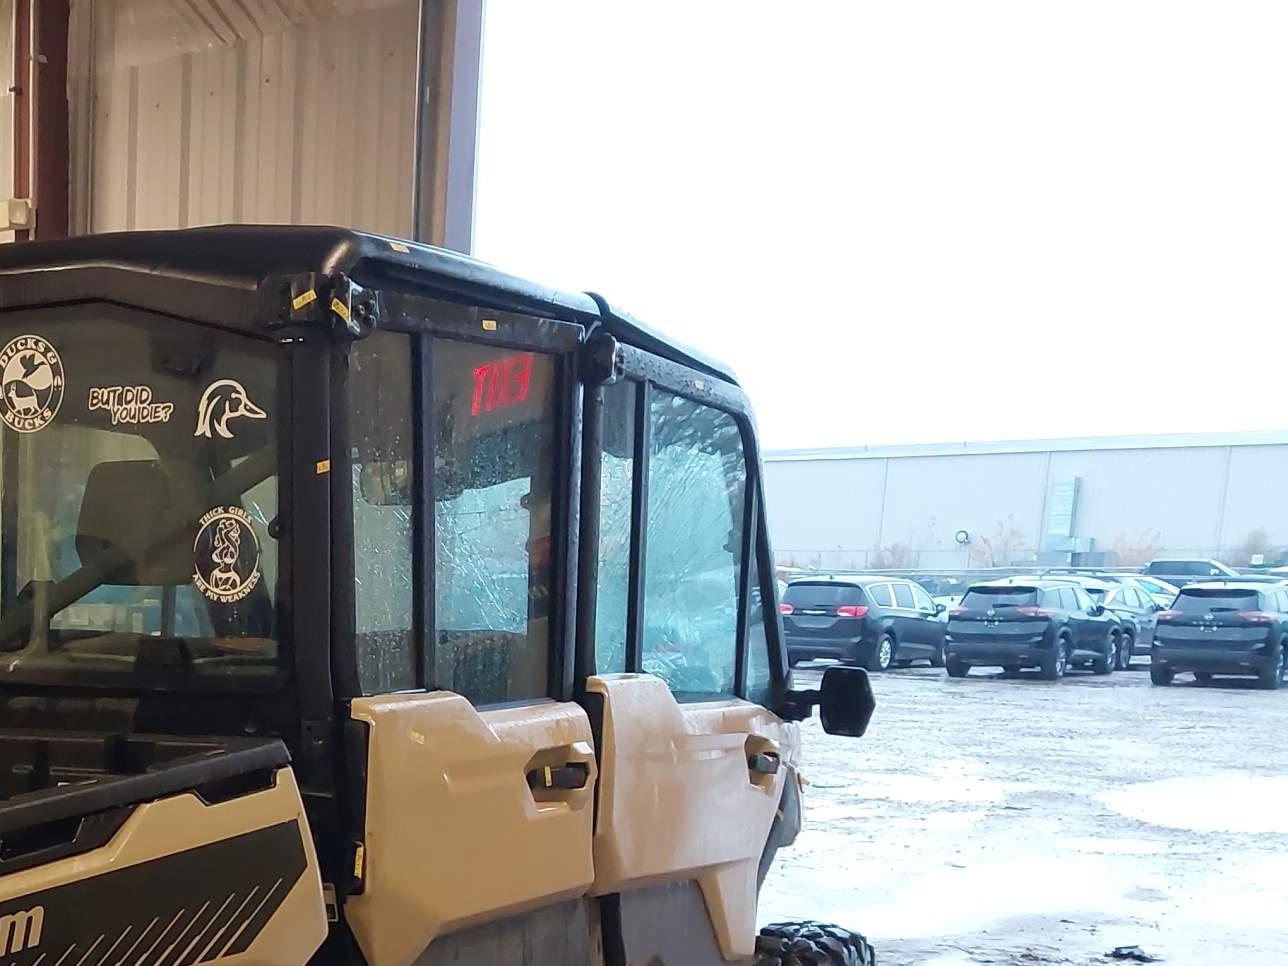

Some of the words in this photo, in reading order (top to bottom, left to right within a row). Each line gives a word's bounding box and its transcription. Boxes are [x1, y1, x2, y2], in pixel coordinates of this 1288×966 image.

[90, 387, 122, 408] BUT
[124, 387, 152, 407] DID
[4, 408, 53, 430] BUCKS
[112, 404, 138, 424] YOU
[140, 403, 172, 422] DIE?
[198, 506, 225, 526] THICK
[228, 506, 253, 524] GIRLS
[192, 574, 205, 593] ARE
[205, 590, 219, 601] MY
[219, 572, 261, 603] WEAKNESS
